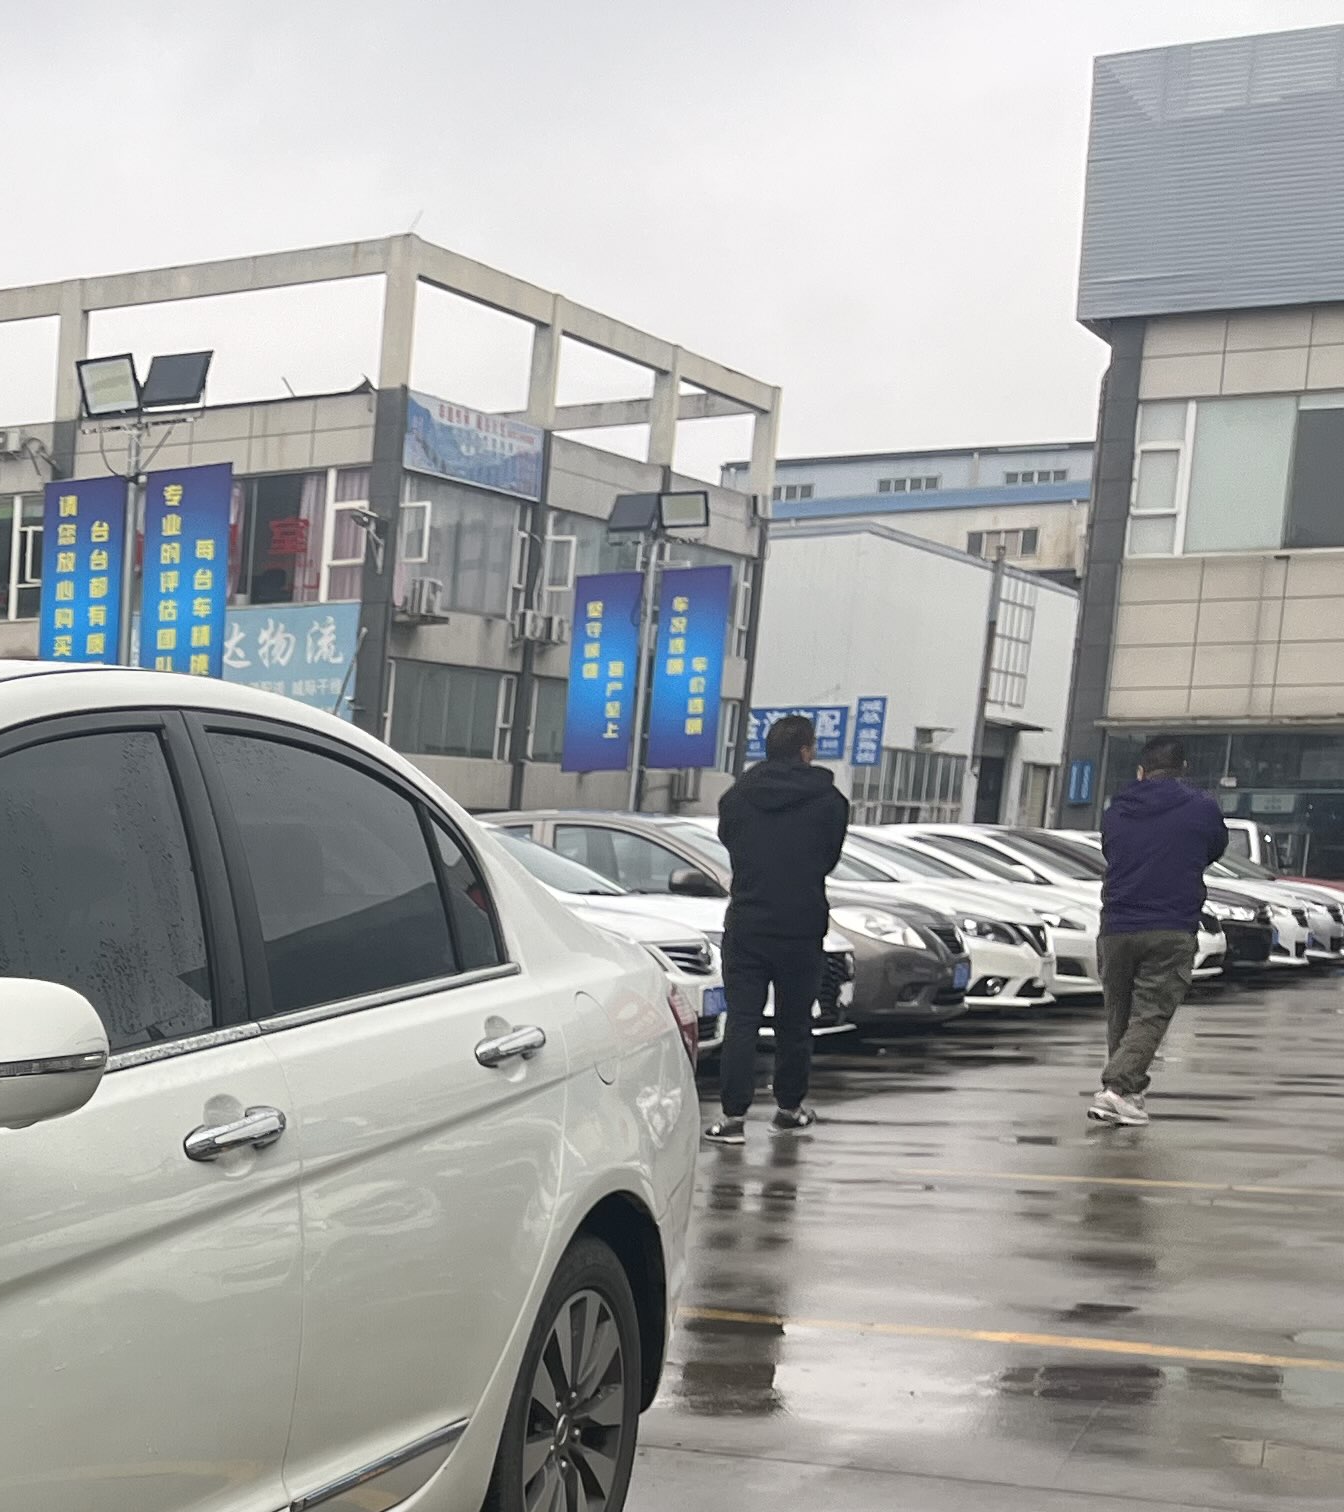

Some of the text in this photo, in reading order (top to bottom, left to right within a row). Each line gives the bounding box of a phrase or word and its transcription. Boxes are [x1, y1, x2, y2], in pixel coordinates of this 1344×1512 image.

[86, 519, 110, 664] 台台都有质
